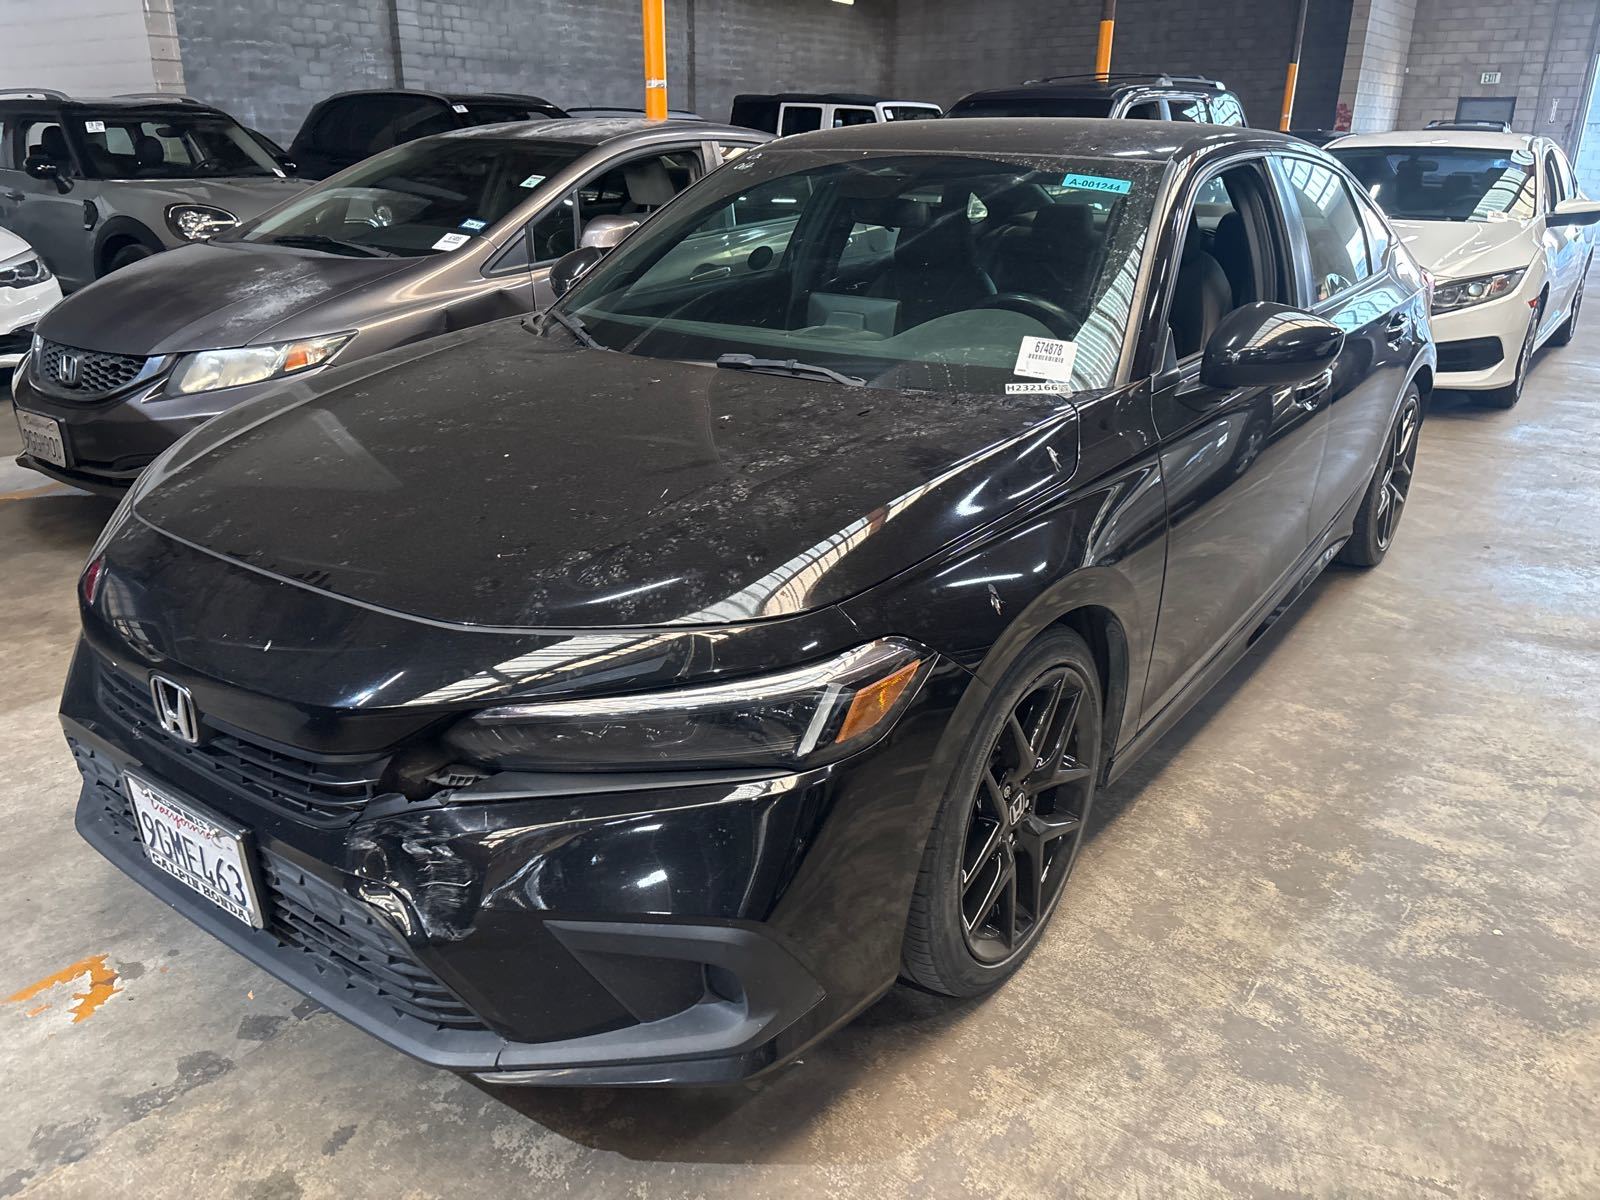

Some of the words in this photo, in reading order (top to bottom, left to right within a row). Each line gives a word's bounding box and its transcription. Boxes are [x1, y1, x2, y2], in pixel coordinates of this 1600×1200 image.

[1068, 178, 1121, 192] A-001244
[1034, 340, 1064, 357] 674878
[1006, 384, 1059, 392] H232166
[141, 811, 247, 907] 9GME463
[152, 853, 200, 892] GALPIN
[203, 883, 249, 924] HONDA
